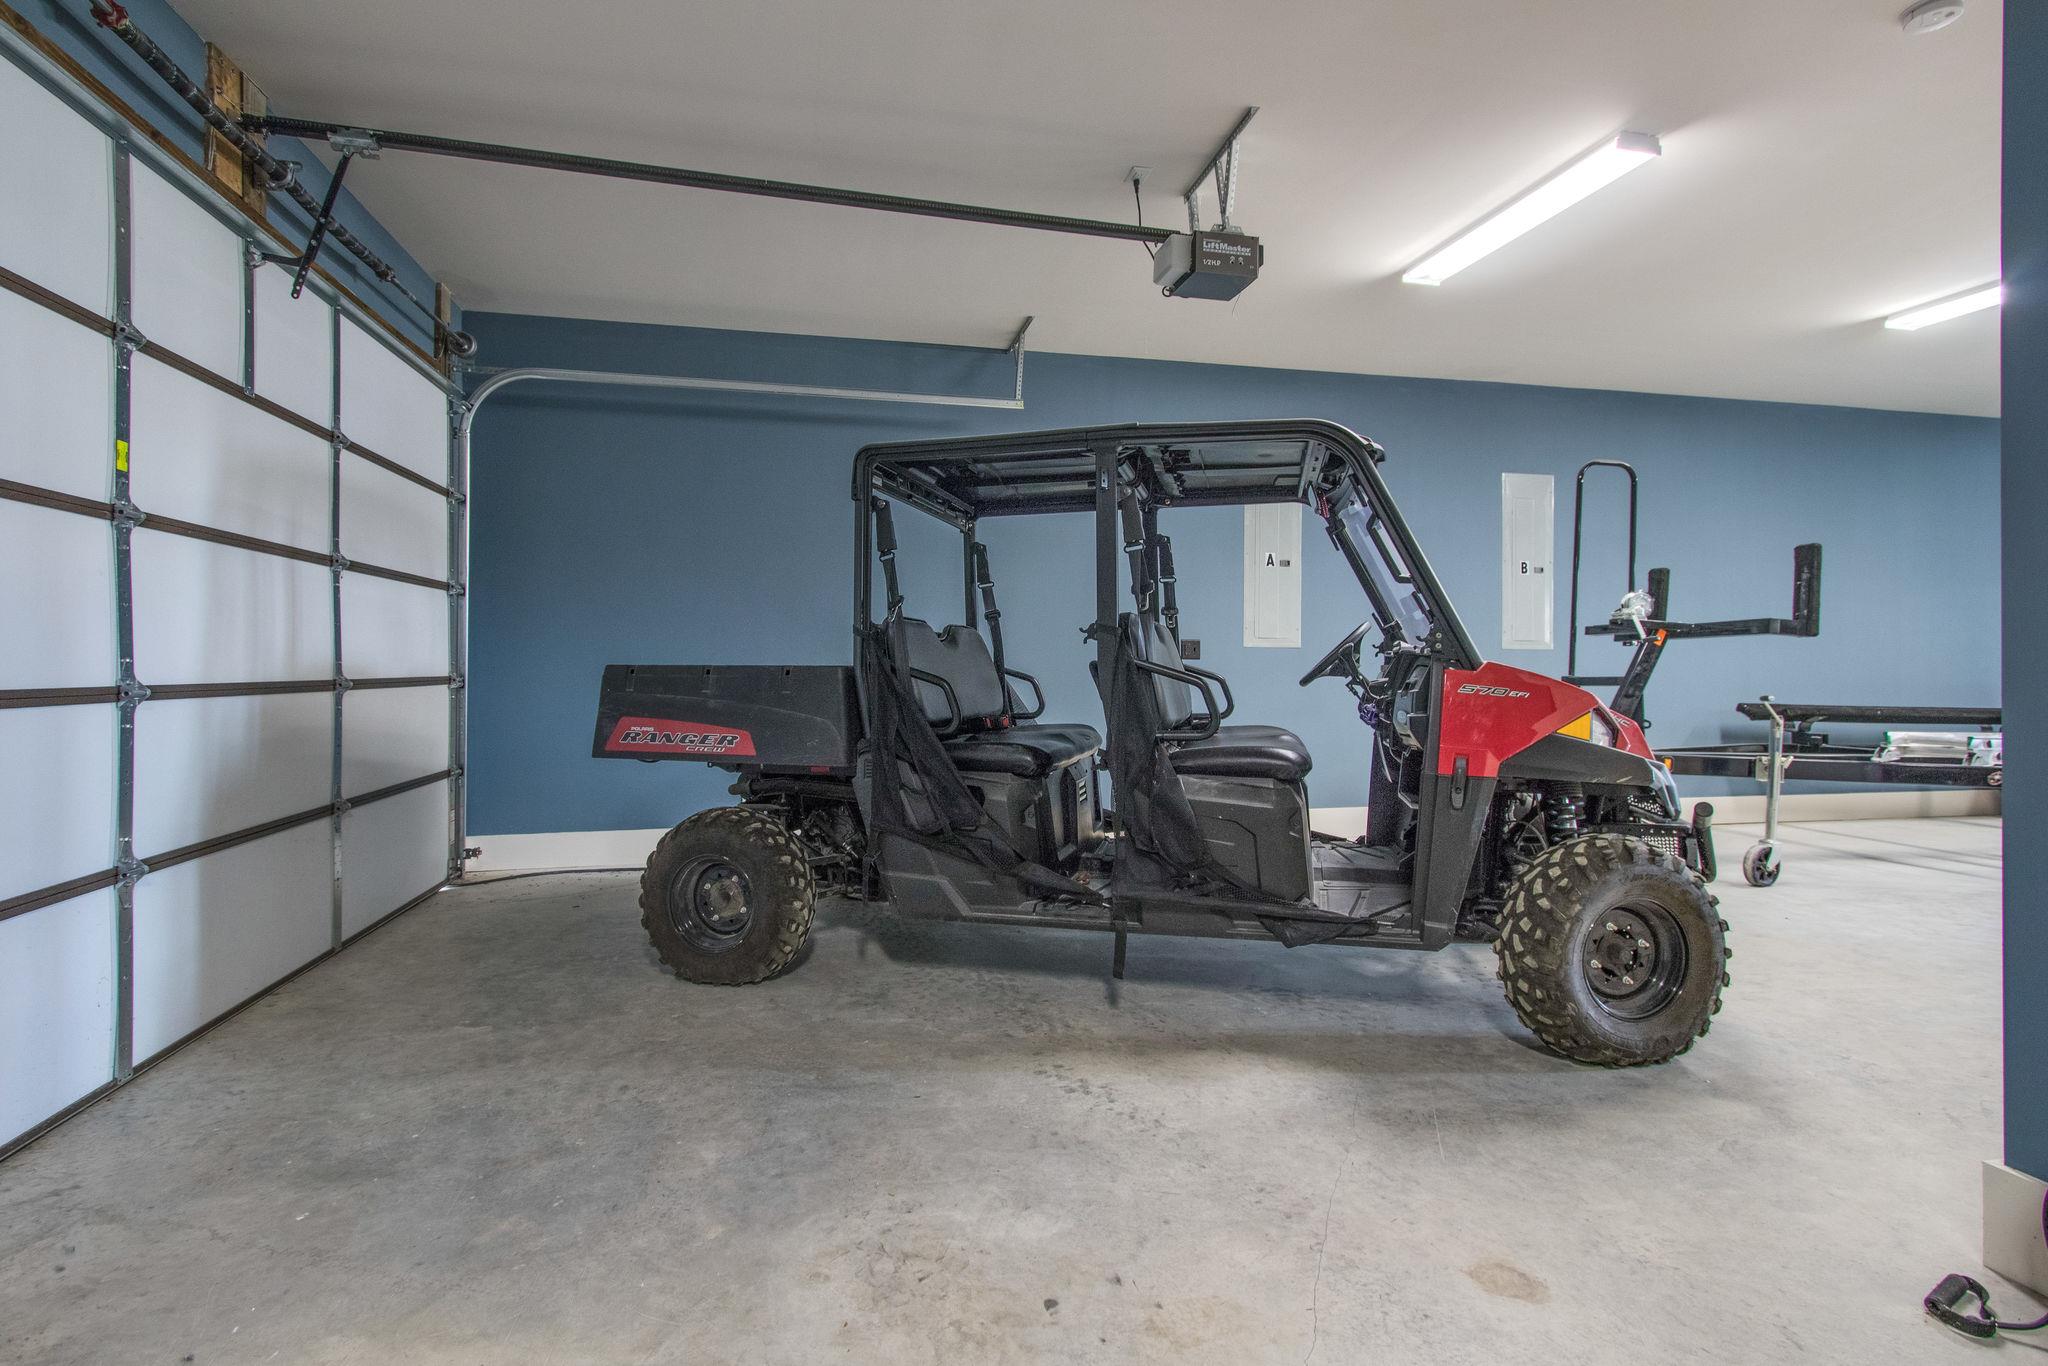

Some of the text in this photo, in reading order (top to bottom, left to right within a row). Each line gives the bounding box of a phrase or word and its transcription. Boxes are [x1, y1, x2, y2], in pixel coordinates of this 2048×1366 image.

[1203, 240, 1251, 253] LiftMaster
[1266, 553, 1275, 567] A
[1521, 561, 1528, 574] B
[1457, 683, 1530, 698] 570 EFI
[619, 731, 739, 747] RANGER
